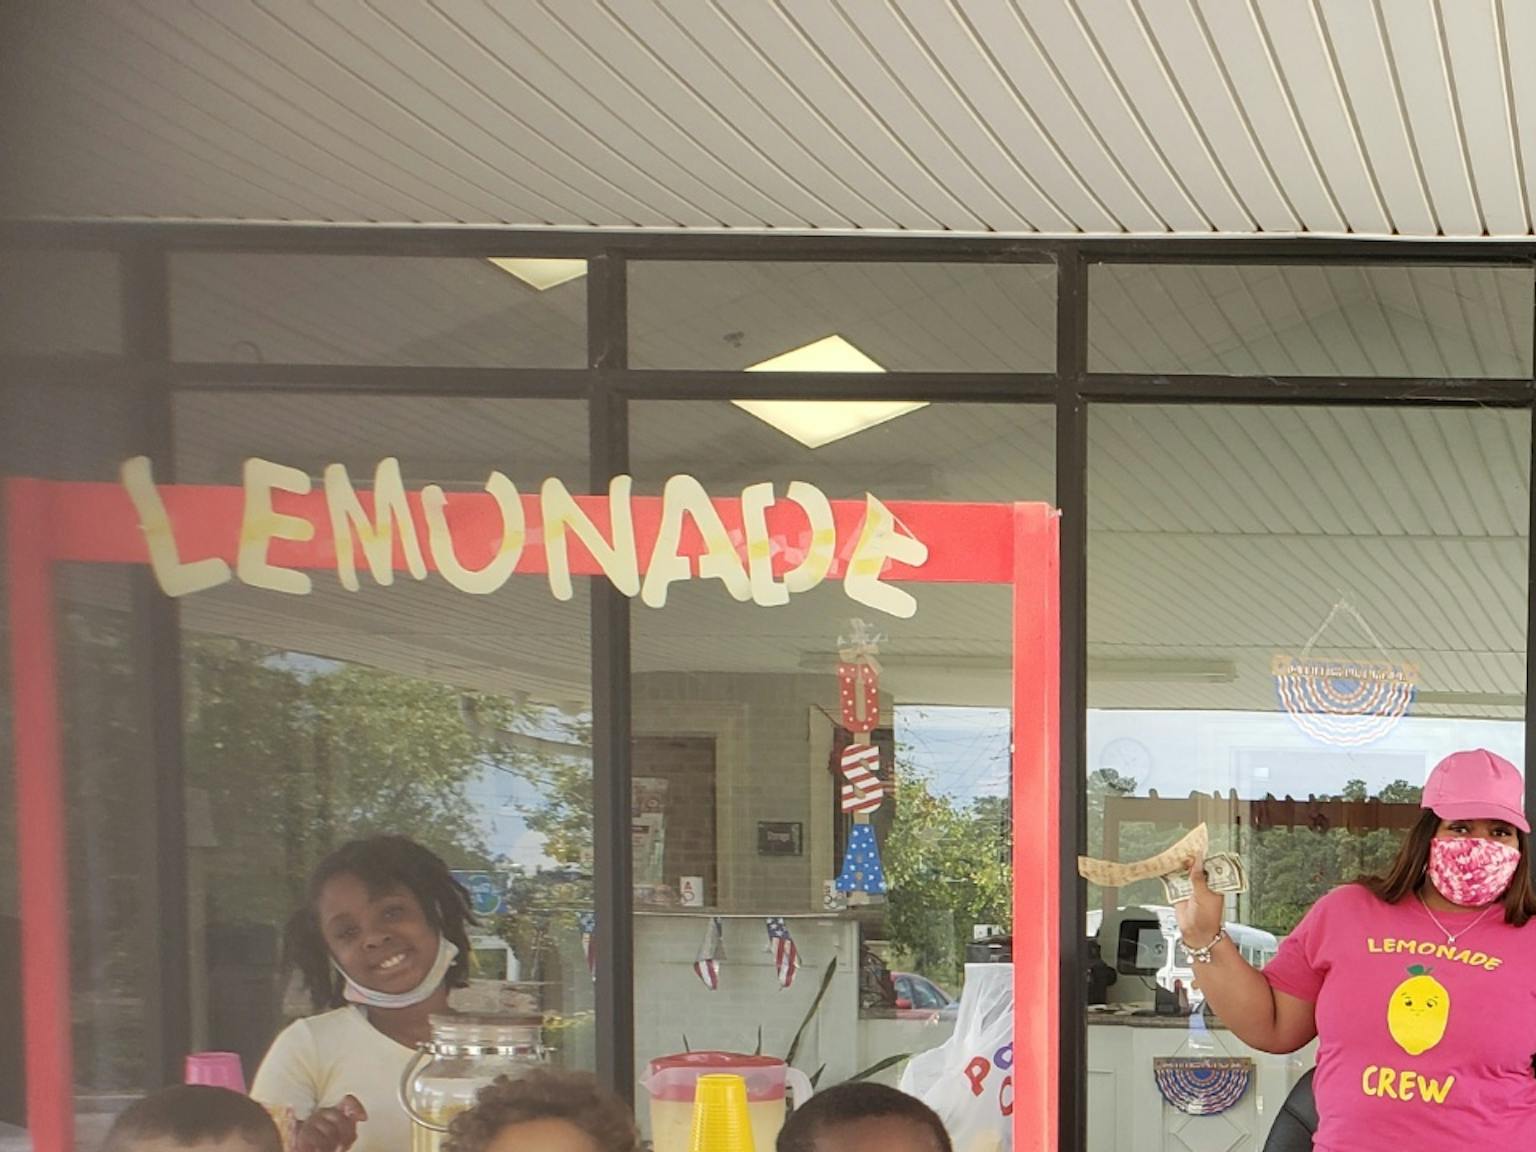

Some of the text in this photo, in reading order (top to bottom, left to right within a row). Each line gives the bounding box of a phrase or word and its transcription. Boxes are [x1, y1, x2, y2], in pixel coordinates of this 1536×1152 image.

[119, 454, 929, 618] LEMONADE
[1367, 938, 1503, 971] LEMONADE
[1362, 1065, 1456, 1104] CREW
